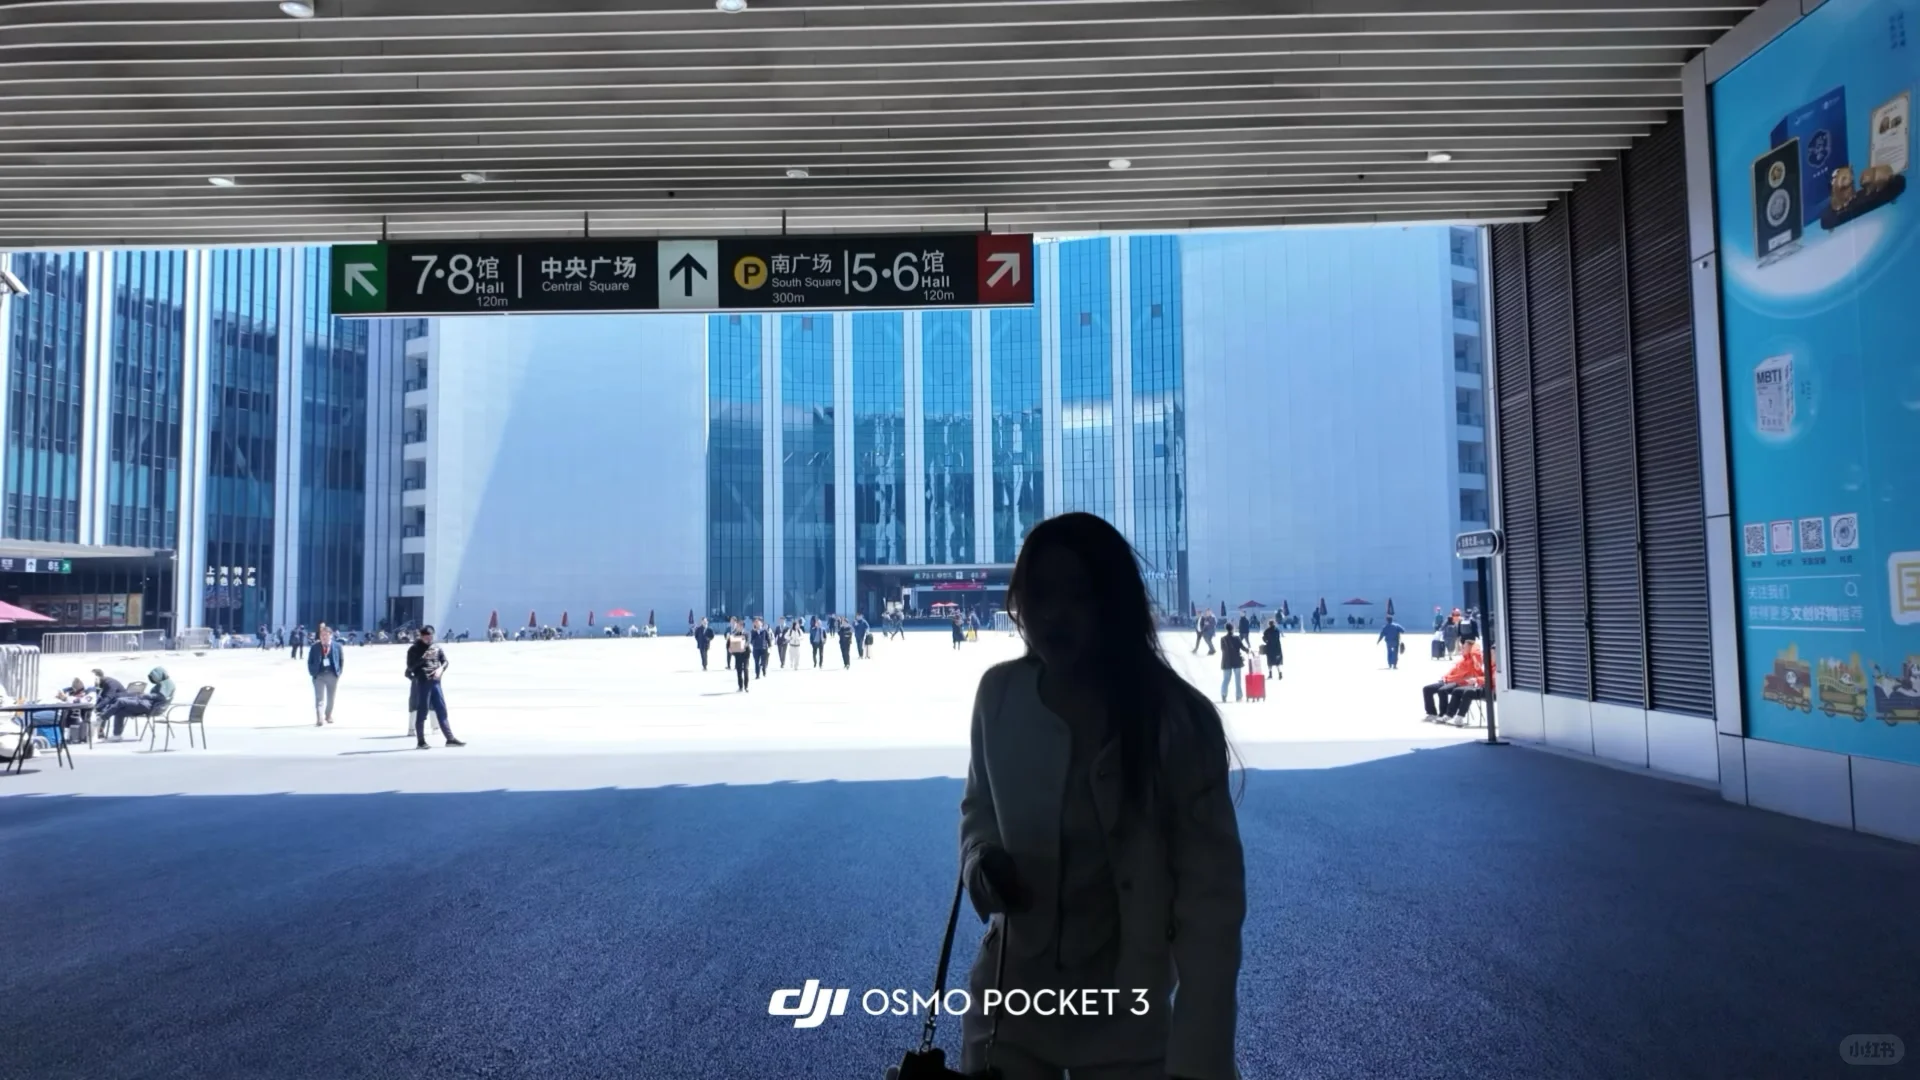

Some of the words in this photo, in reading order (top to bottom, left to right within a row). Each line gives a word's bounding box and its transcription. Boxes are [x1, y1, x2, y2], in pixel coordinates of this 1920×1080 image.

[541, 256, 637, 279] 中央广场
[771, 254, 832, 274] 南广场
[742, 263, 761, 285] P
[475, 282, 504, 294] Hall
[542, 281, 582, 292] Central
[589, 281, 630, 293] Square
[771, 278, 802, 288] South
[804, 277, 842, 290] Square
[921, 276, 950, 288] Hall
[477, 296, 508, 307] 120m
[772, 292, 805, 303] 300m
[923, 290, 955, 301] 120m
[1757, 368, 1782, 384] MBTI
[206, 566, 256, 576] 上海特产
[1748, 584, 1790, 600] 关注我们
